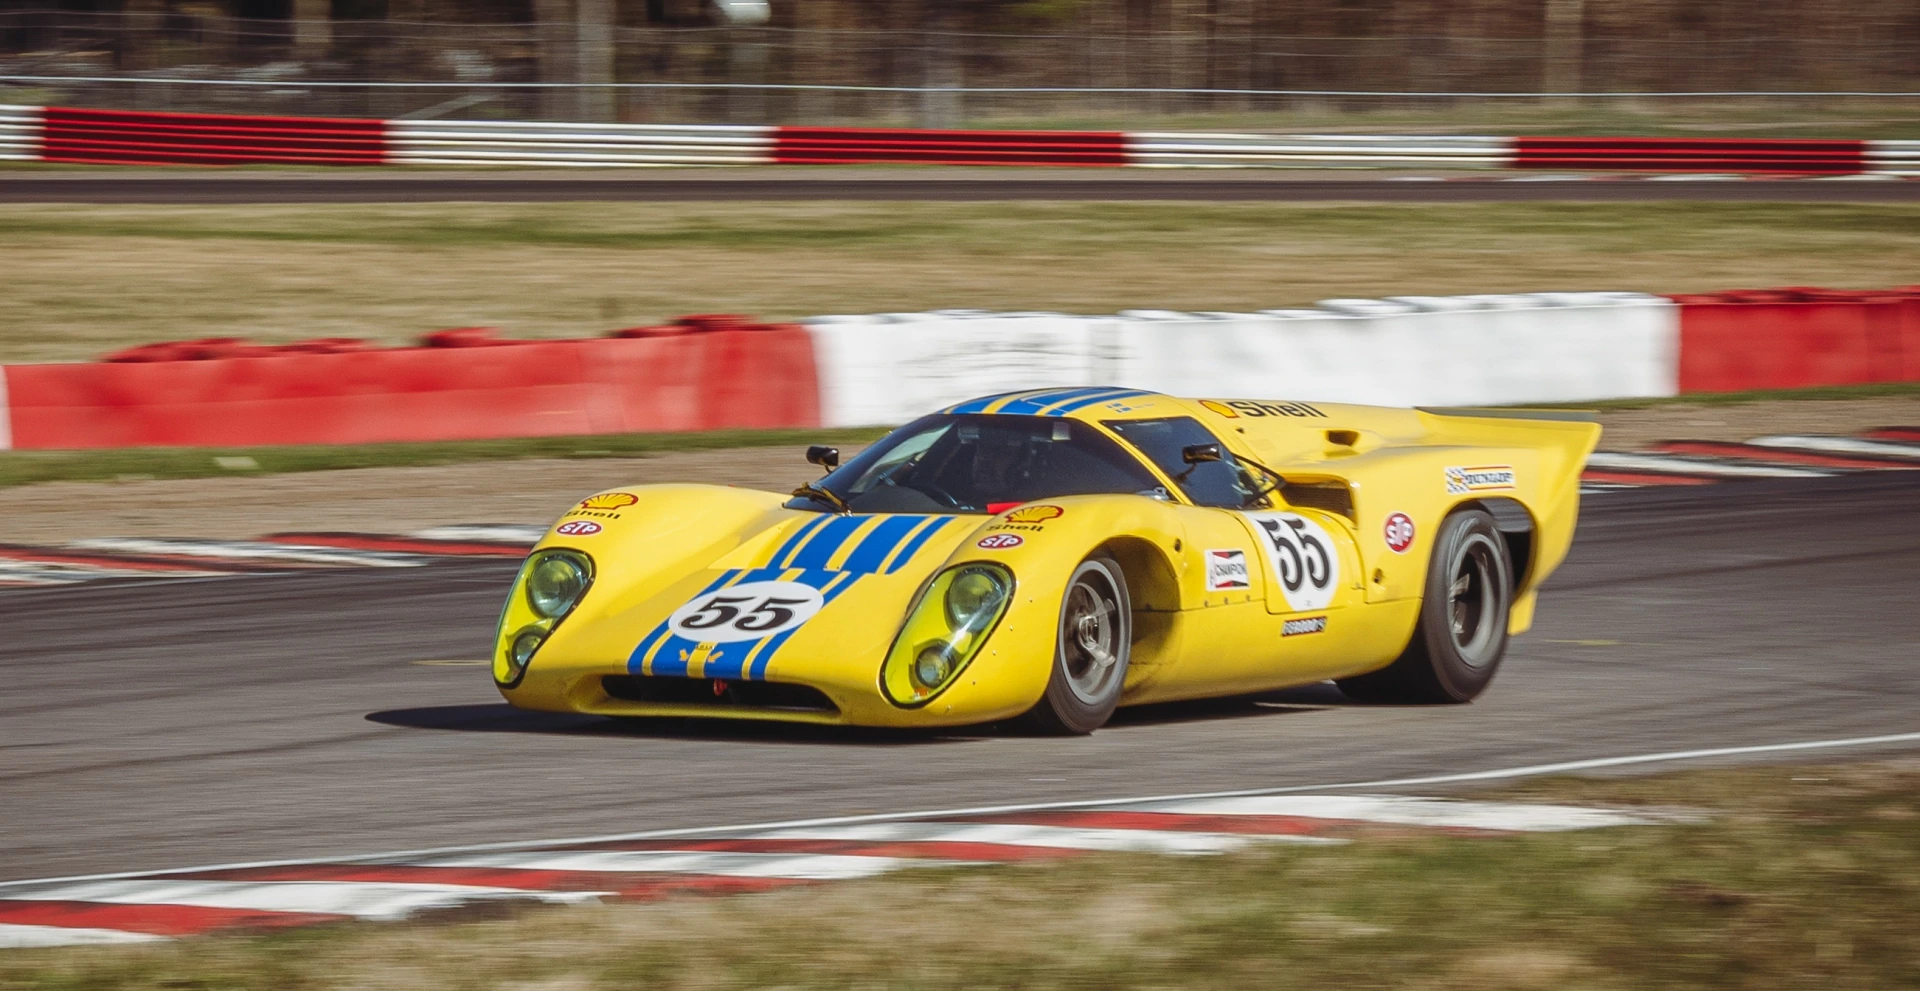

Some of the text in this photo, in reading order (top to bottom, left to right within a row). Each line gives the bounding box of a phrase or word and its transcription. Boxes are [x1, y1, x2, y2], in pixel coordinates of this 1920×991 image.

[1225, 401, 1328, 418] Shell
[564, 510, 621, 519] Shell
[560, 521, 598, 533] STP
[1386, 516, 1413, 546] STP
[980, 535, 1019, 547] STP
[1255, 517, 1330, 592] 55
[678, 596, 812, 632] 55
